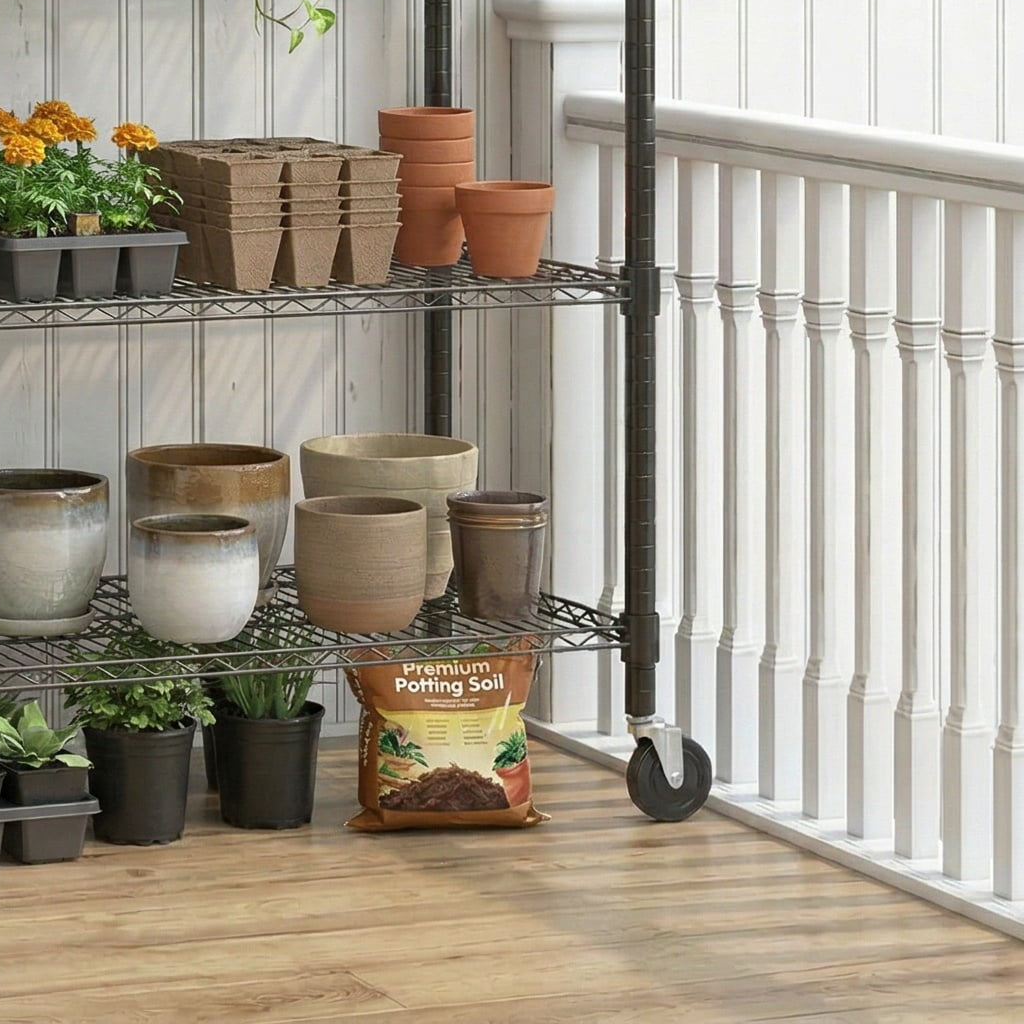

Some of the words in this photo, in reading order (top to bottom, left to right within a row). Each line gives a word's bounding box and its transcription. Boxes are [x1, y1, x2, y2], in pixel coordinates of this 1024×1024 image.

[402, 660, 490, 675] Premium
[395, 677, 463, 697] Potting
[468, 673, 504, 692] Soil
